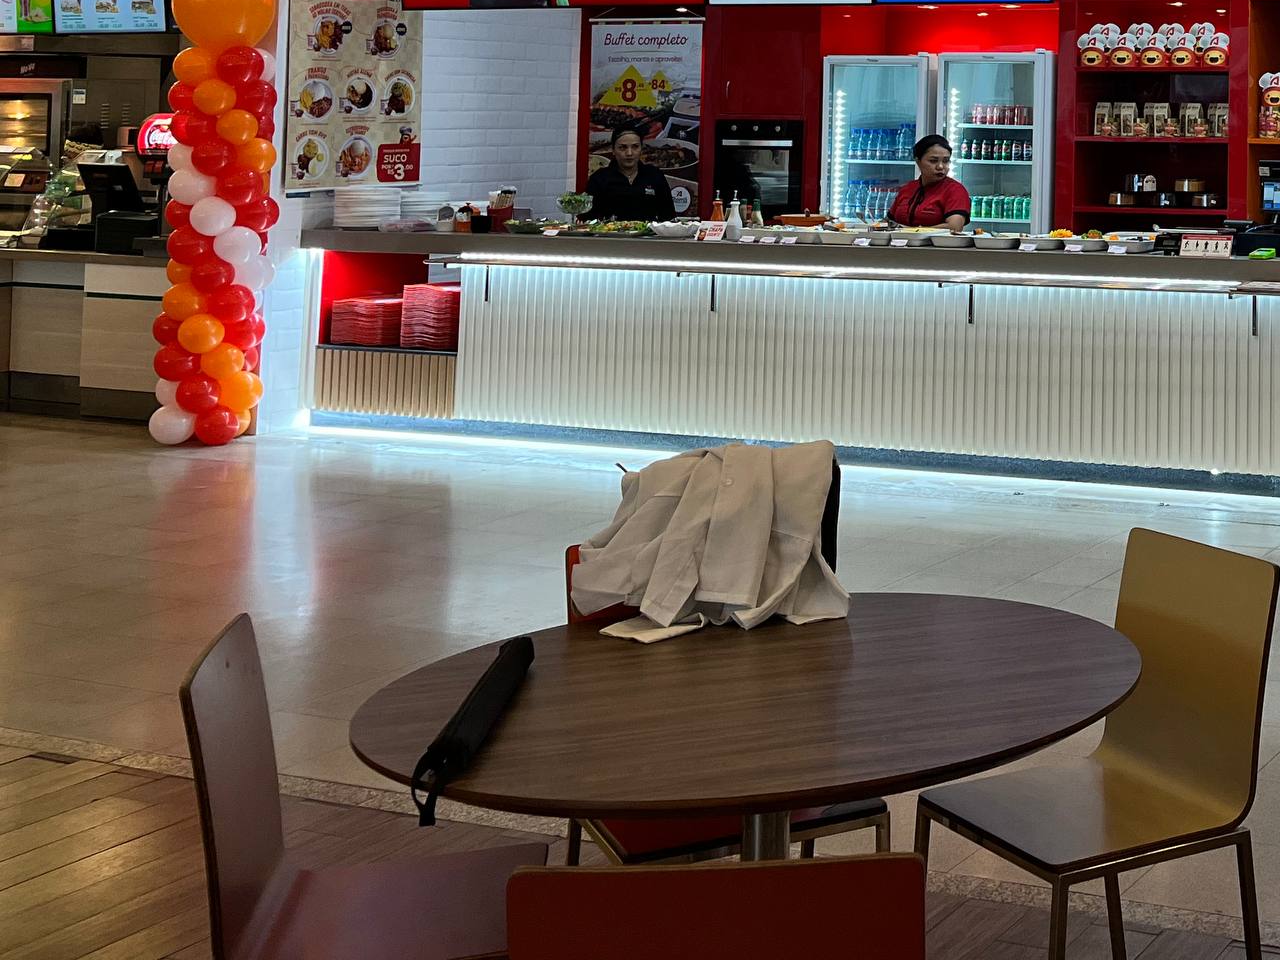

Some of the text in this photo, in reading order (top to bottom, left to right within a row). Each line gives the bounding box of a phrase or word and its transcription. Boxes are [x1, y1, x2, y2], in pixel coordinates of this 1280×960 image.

[604, 33, 688, 49] Buffet completo
[384, 154, 407, 163] SUCO
